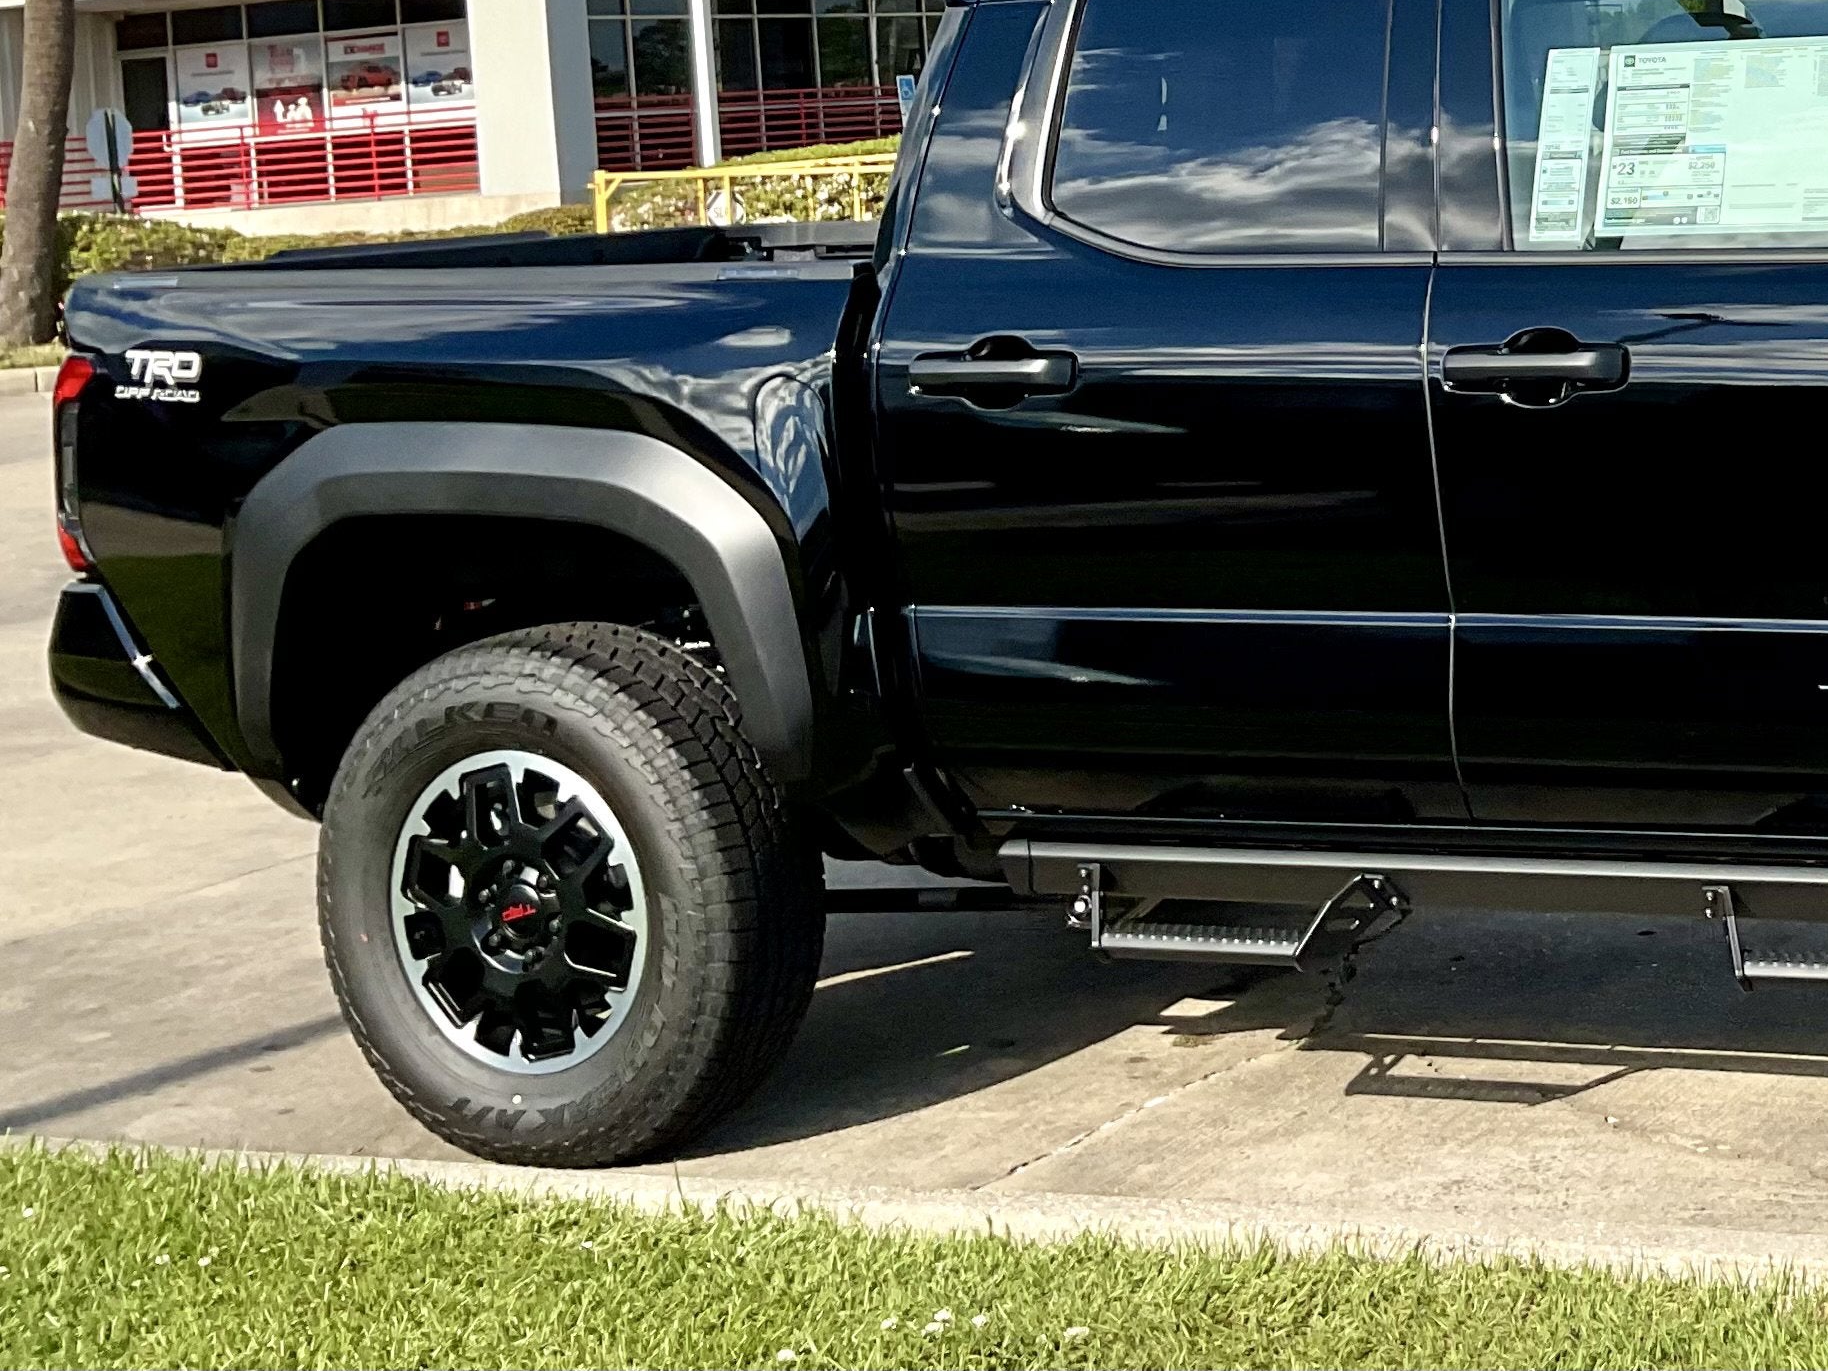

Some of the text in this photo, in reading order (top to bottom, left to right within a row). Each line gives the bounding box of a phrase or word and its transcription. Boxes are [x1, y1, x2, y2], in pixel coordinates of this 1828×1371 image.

[1617, 162, 1635, 176] 23
[125, 350, 202, 385] TRD
[115, 385, 151, 399] OFF
